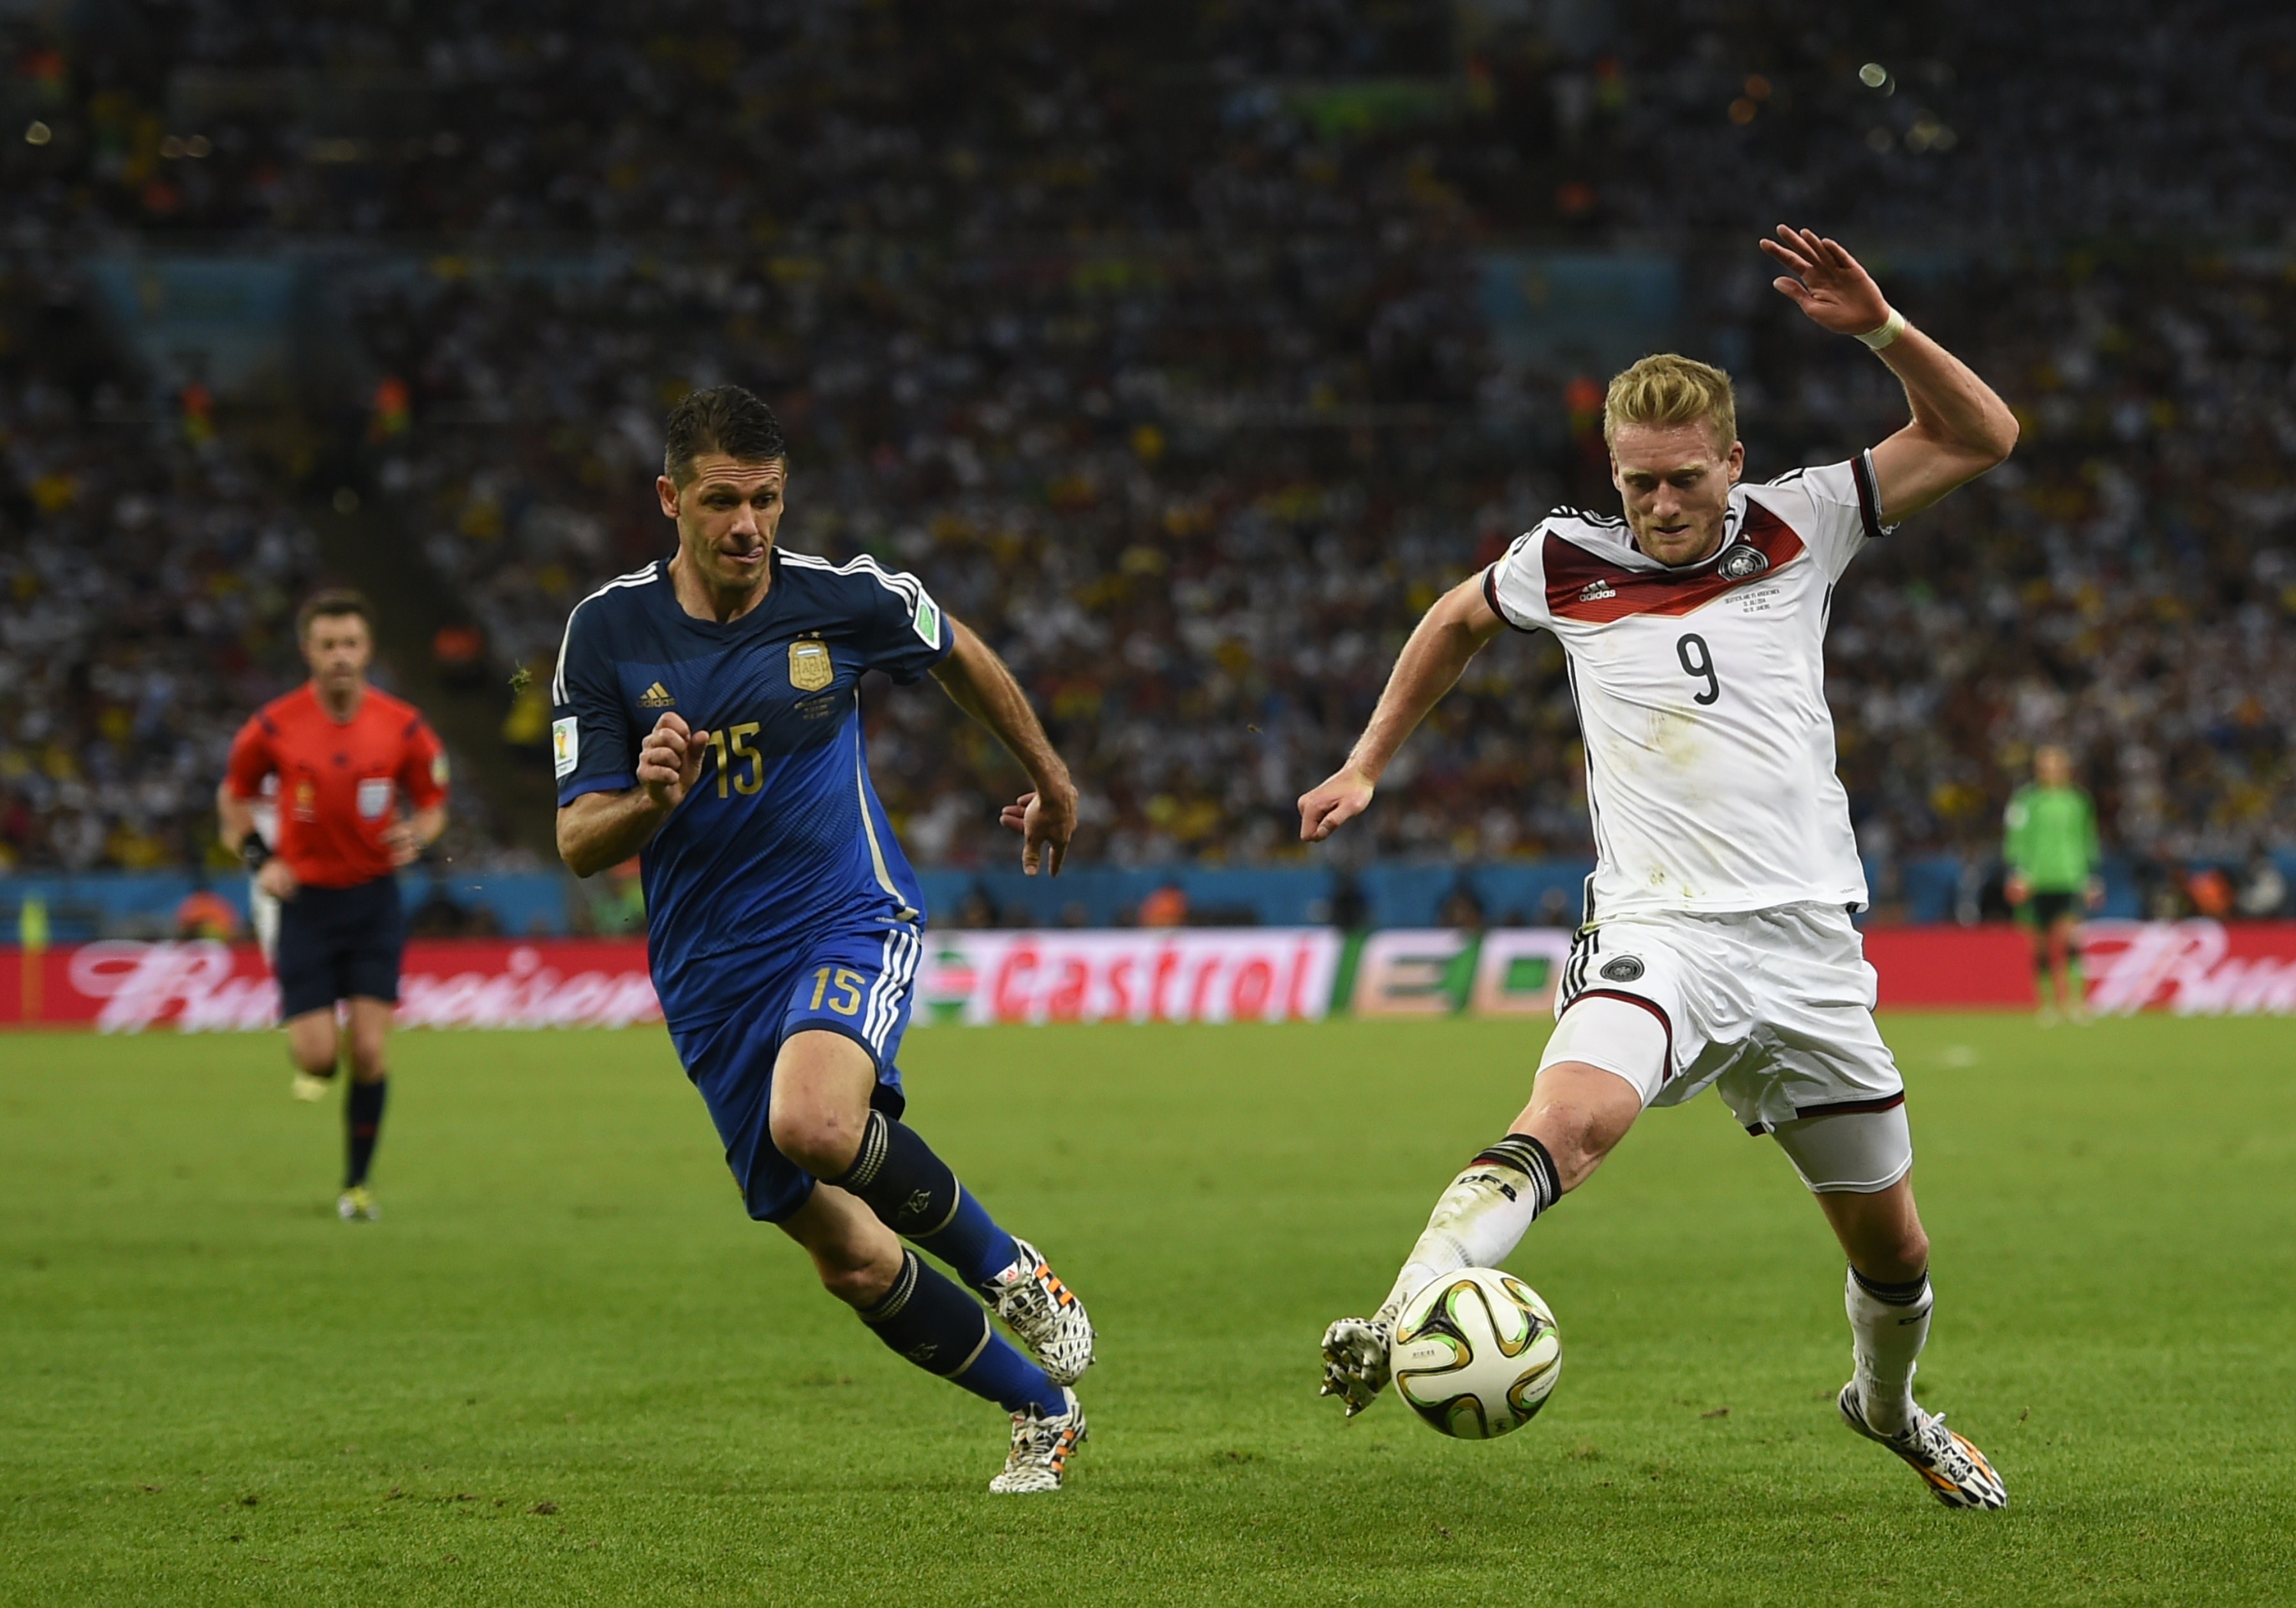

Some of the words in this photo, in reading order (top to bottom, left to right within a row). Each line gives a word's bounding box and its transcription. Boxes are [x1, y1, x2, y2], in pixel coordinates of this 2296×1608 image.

[1579, 589, 1616, 603] adidas
[1676, 633, 1719, 705] 9
[637, 697, 677, 708] adidas
[707, 721, 763, 799] 15
[809, 967, 865, 1016] 15
[993, 935, 1314, 1022] Castrol
